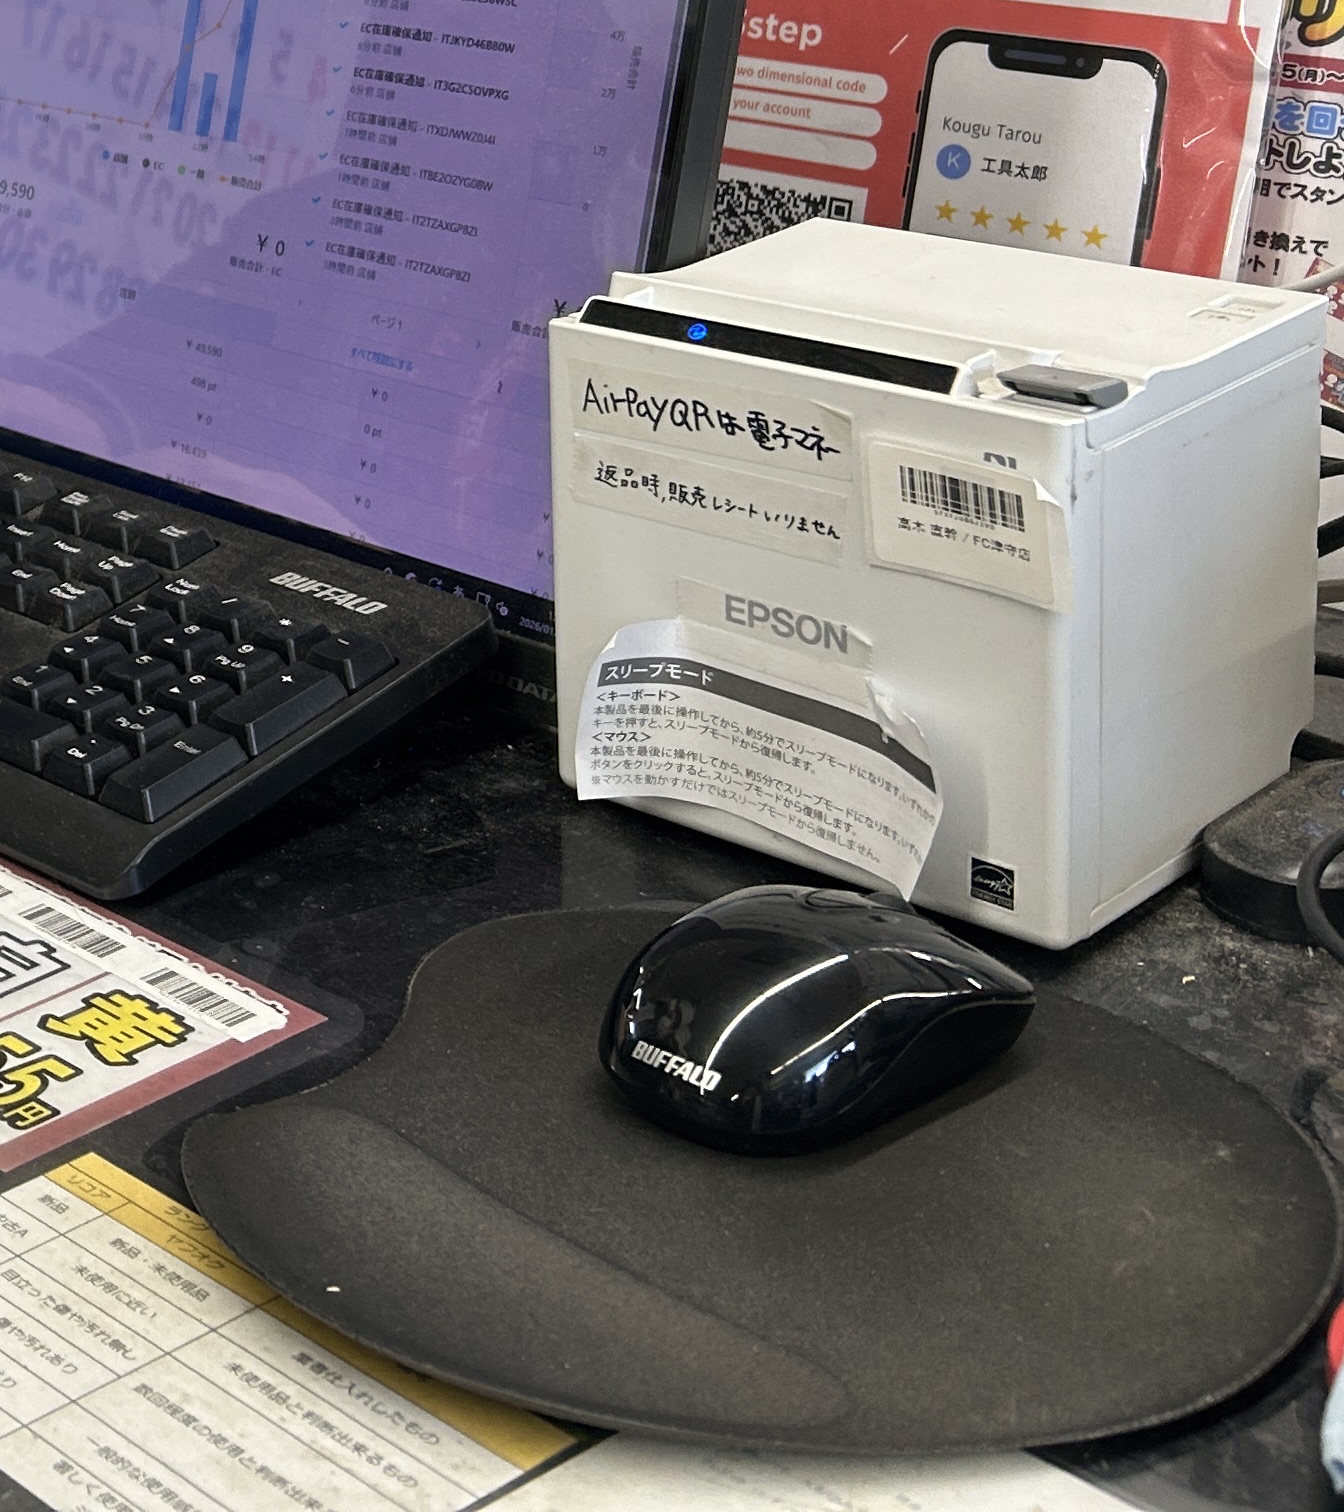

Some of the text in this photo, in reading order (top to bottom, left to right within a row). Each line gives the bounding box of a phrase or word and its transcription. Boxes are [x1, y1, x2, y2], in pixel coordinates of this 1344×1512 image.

[757, 66, 833, 90] dimensional
[835, 78, 867, 95] code
[762, 99, 812, 120] account
[942, 115, 1044, 146] Kougu Tarou
[946, 151, 961, 170] K
[980, 156, 1049, 183] 工具太郎
[269, 571, 389, 616] BUFFALO
[724, 593, 849, 654] EPSON
[603, 661, 714, 686] スリープモード
[37, 988, 196, 1067] 黄
[630, 1038, 724, 1092] BUFFALO
[36, 1193, 70, 1215] 新品
[109, 1236, 211, 1303] 新品・未使用品
[166, 1232, 225, 1272] ヤフオク
[70, 1262, 159, 1320] 未使用に近い
